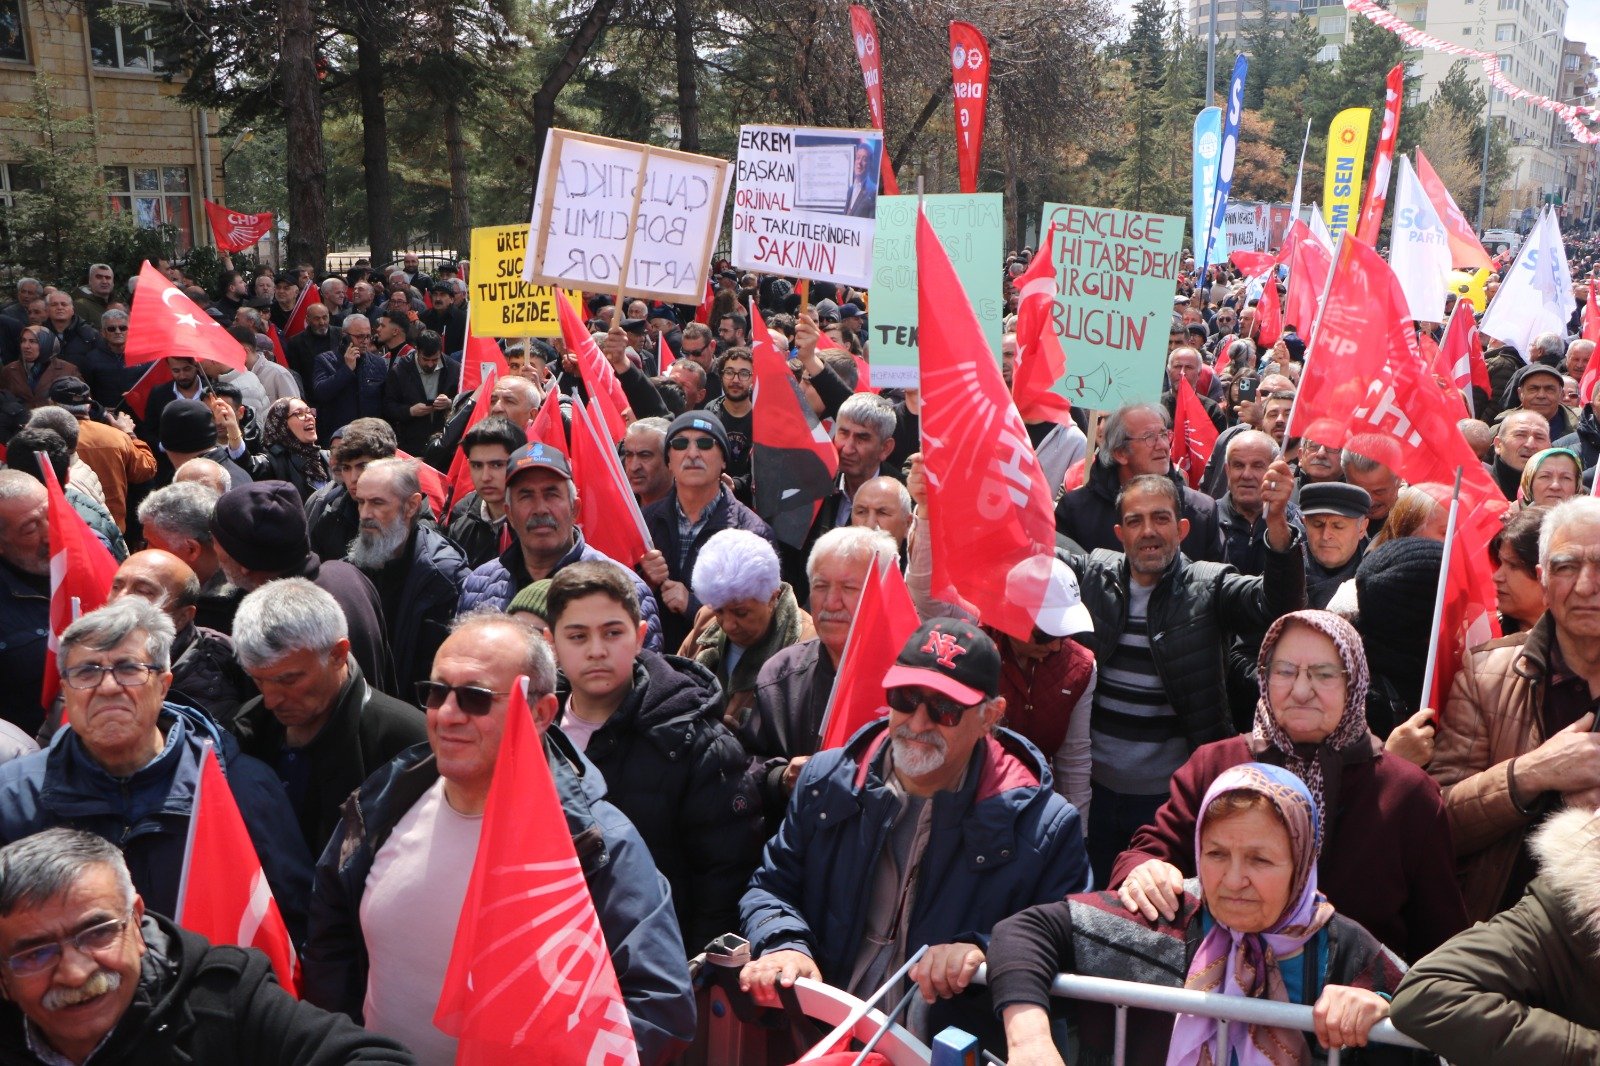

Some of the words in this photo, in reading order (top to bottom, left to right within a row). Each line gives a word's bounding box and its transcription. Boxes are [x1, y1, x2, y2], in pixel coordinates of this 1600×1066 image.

[741, 131, 791, 154] EKREM
[738, 160, 795, 182] BAŞKAN
[1334, 157, 1354, 197] SEN
[736, 188, 791, 212] ORJİNAL
[735, 211, 757, 234] DİR
[762, 217, 861, 247] TAKLİTLERİNDEN
[1051, 207, 1164, 244] GENÇLİĞE
[754, 236, 836, 274] SAKININ
[1055, 265, 1134, 302] İRGÜN
[1317, 328, 1358, 357] HP
[921, 631, 967, 669] NY
